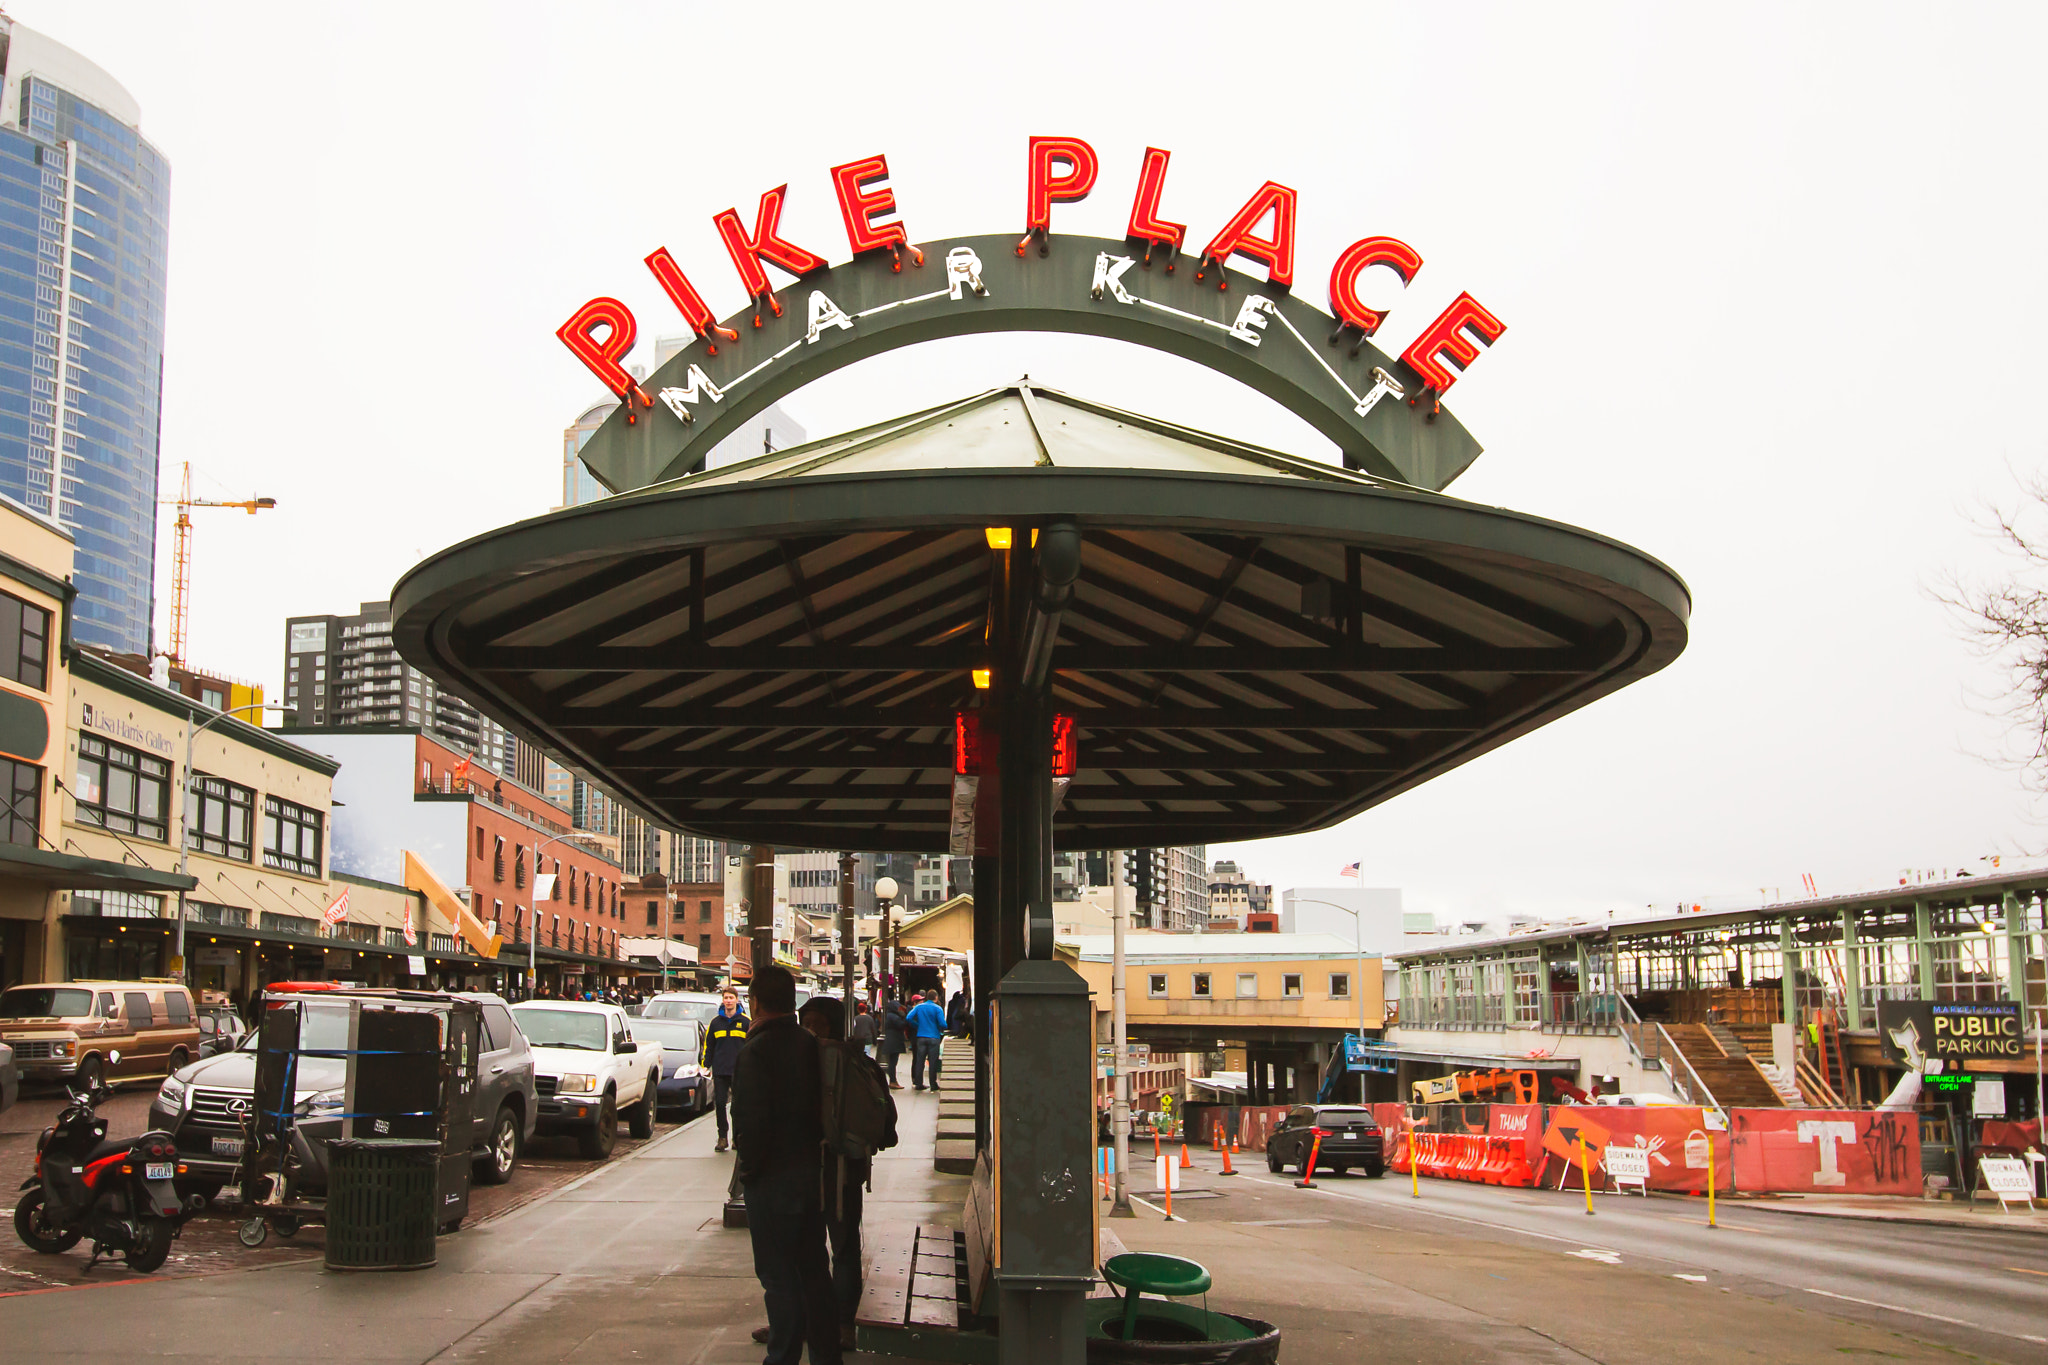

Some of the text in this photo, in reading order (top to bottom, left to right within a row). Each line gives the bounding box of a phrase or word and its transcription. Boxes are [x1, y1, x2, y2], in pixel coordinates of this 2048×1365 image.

[555, 135, 1508, 397] PIKE PLACE
[658, 246, 1405, 425] MARKET
[94, 710, 175, 758] Lisa Harris Gallery
[1932, 1005, 2017, 1015] MARKET PLACE
[1934, 1016, 2018, 1036] PUBLIC
[1936, 1038, 2020, 1055] PARKING
[1925, 1075, 1955, 1083] ENTRANCE
[1956, 1075, 1973, 1083] LANE
[1939, 1083, 1959, 1091] OPEN
[1607, 1150, 1645, 1160] SIDEWALK
[1610, 1163, 1646, 1173] CLOSED
[1984, 1163, 2024, 1173] SIDEWALK
[1991, 1177, 2029, 1188] CLOSED
